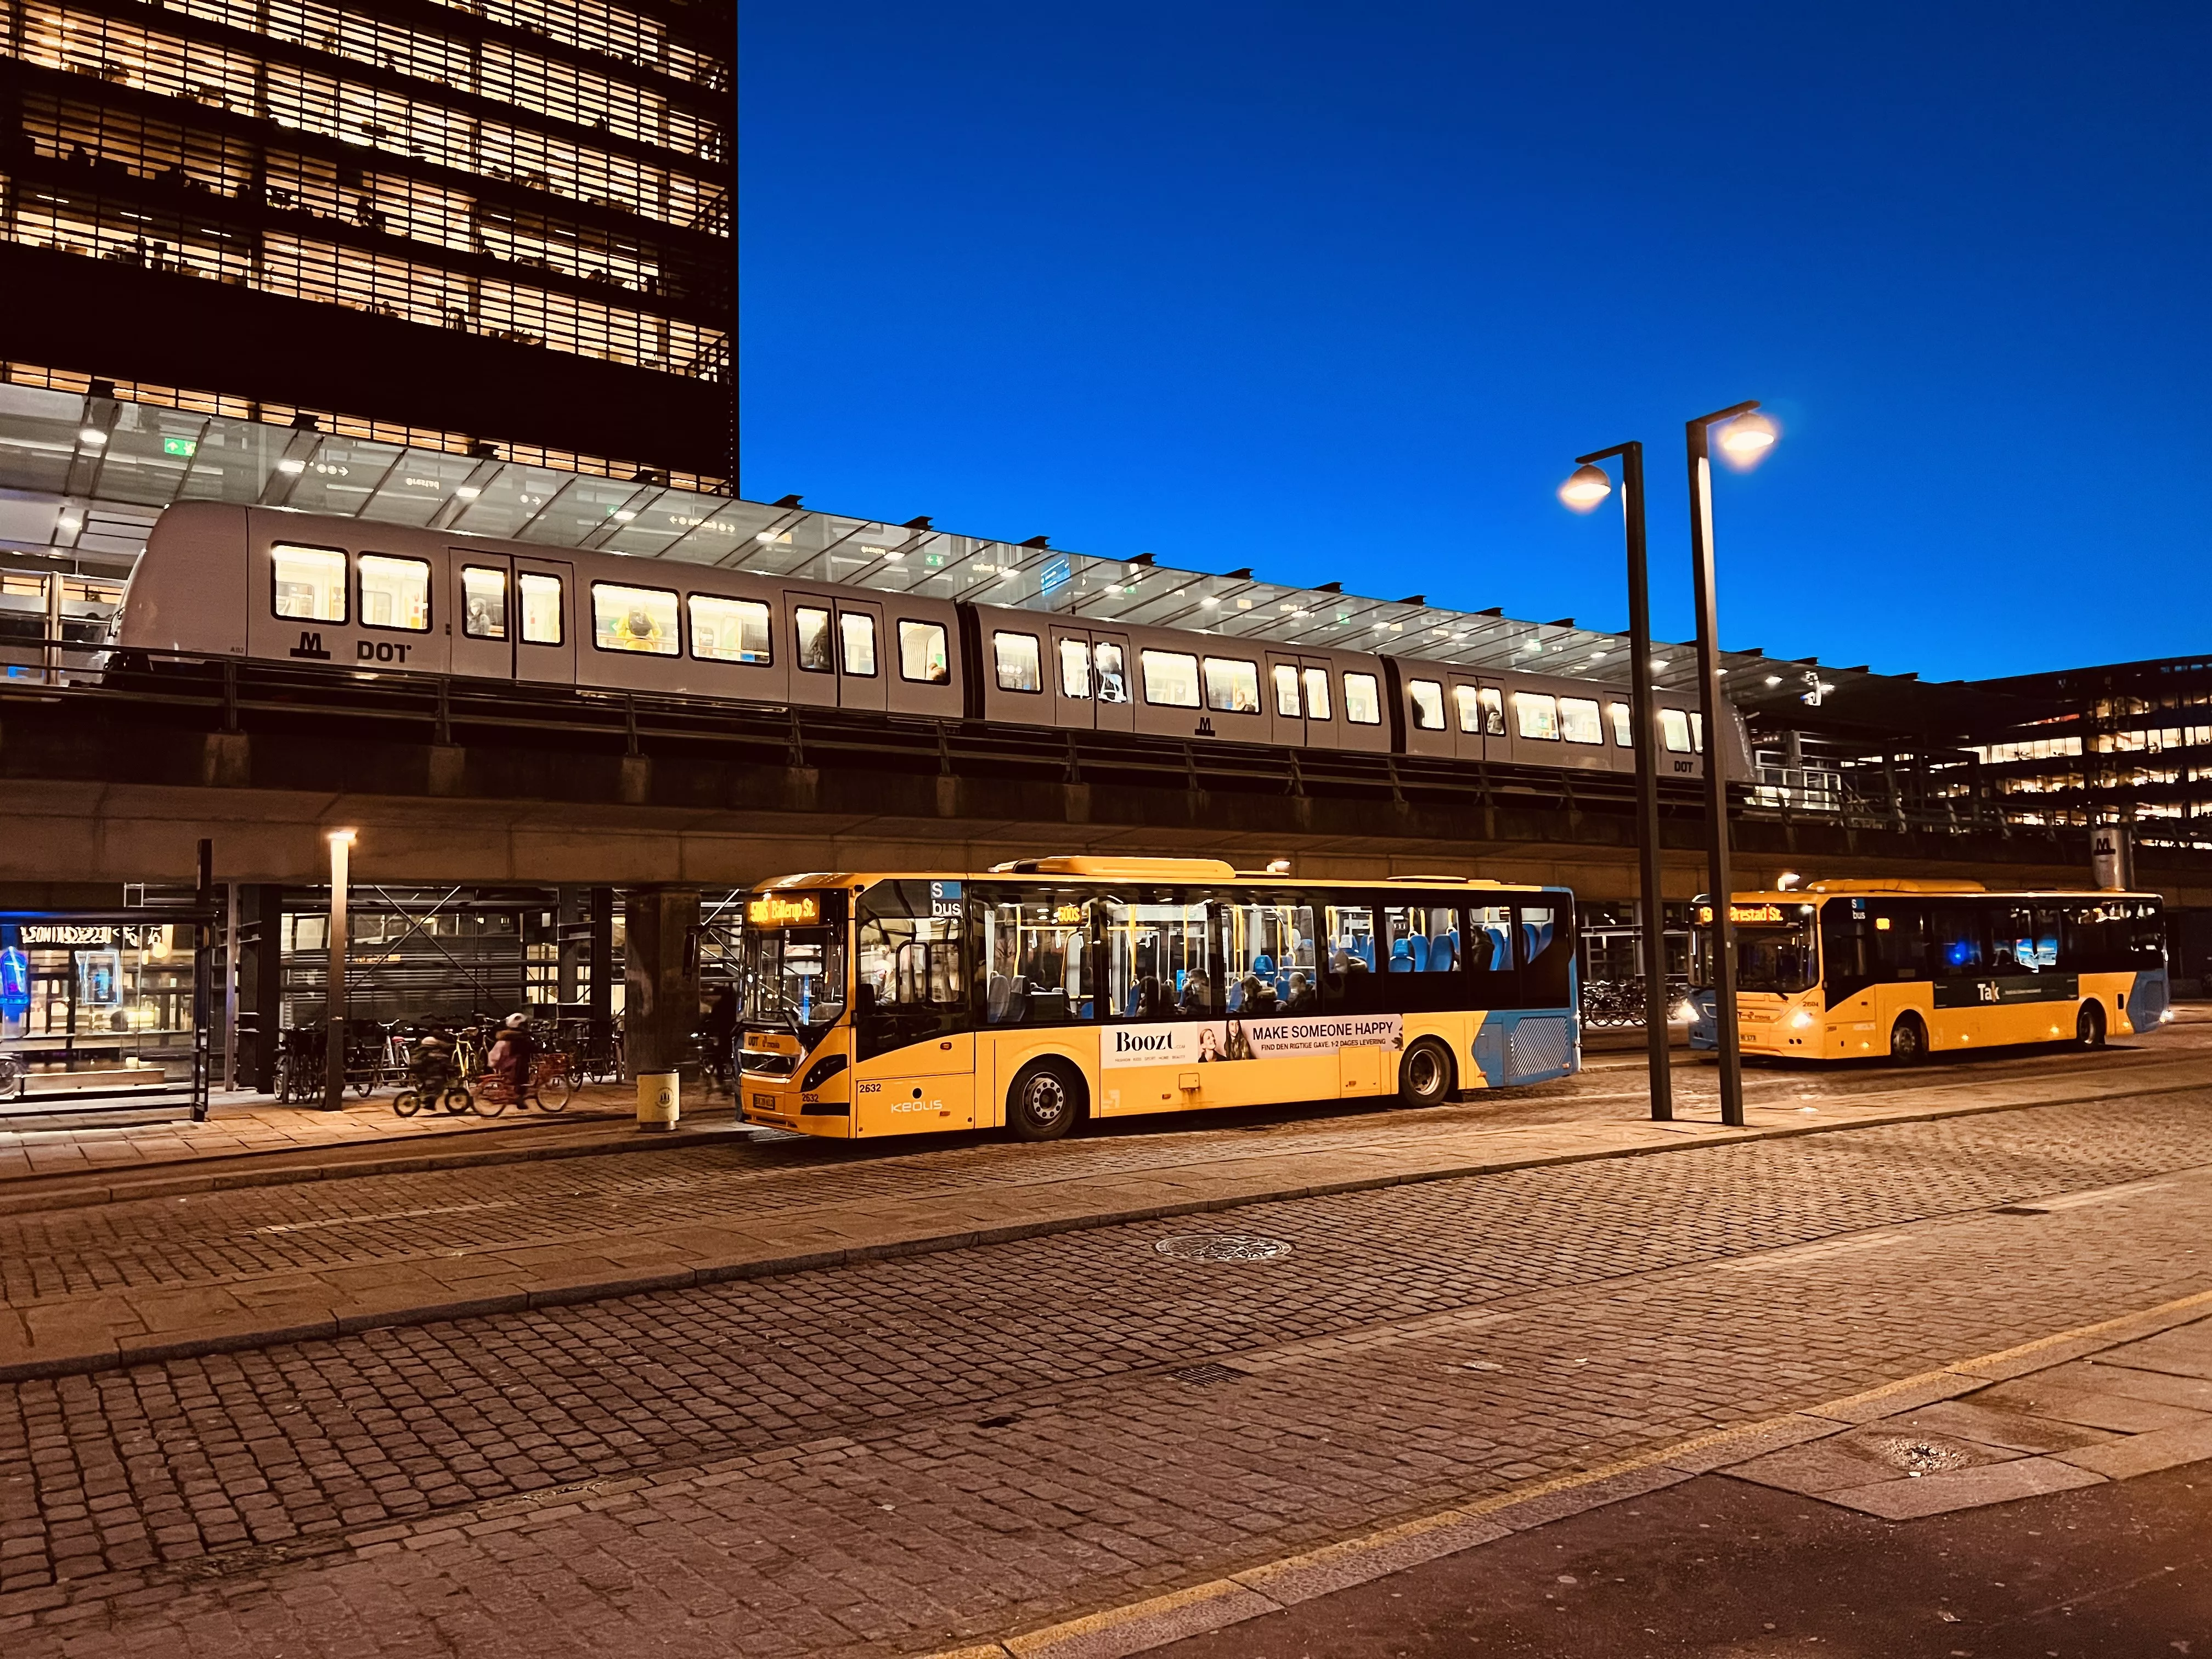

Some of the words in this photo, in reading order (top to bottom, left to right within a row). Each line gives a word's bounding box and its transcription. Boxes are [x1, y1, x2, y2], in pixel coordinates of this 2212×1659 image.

[357, 640, 412, 663] DOT
[1674, 760, 1694, 773] DOT
[932, 882, 943, 898] S
[771, 900, 802, 922] Ballerup
[803, 898, 816, 917] St.
[932, 900, 961, 916] bus
[1852, 899, 1857, 909] S
[1058, 907, 1080, 922] 500S
[1852, 910, 1866, 919] bus
[1977, 981, 2000, 1003] Tak
[1253, 1026, 1288, 1040] MAKE
[1291, 1023, 1352, 1038] SOMEONE
[1355, 1022, 1393, 1035] HAPPY
[1115, 1030, 1173, 1052] Boozt
[859, 1084, 881, 1093] 2632
[802, 1093, 819, 1103] 2632
